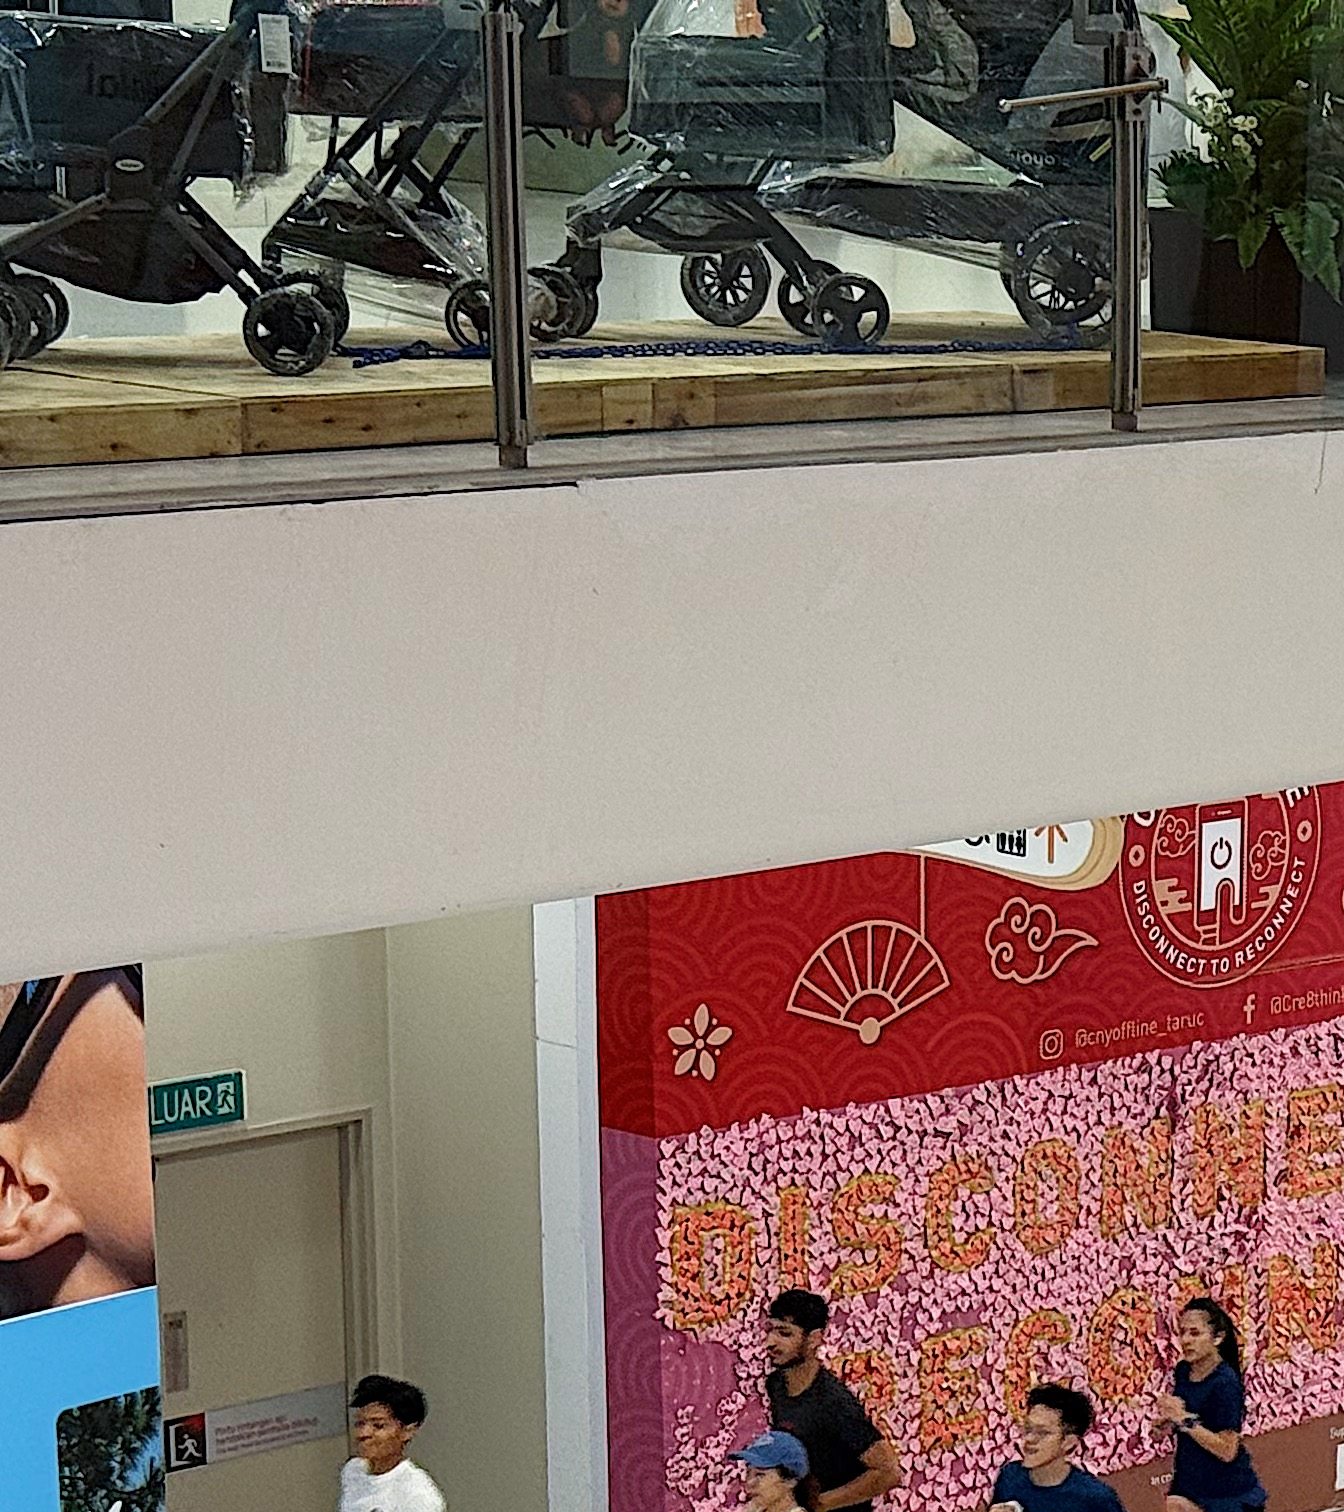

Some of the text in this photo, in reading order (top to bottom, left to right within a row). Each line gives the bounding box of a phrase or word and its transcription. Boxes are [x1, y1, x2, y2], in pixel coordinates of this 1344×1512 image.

[1133, 858, 1306, 976] DISCONNECT TO RECONNECT
